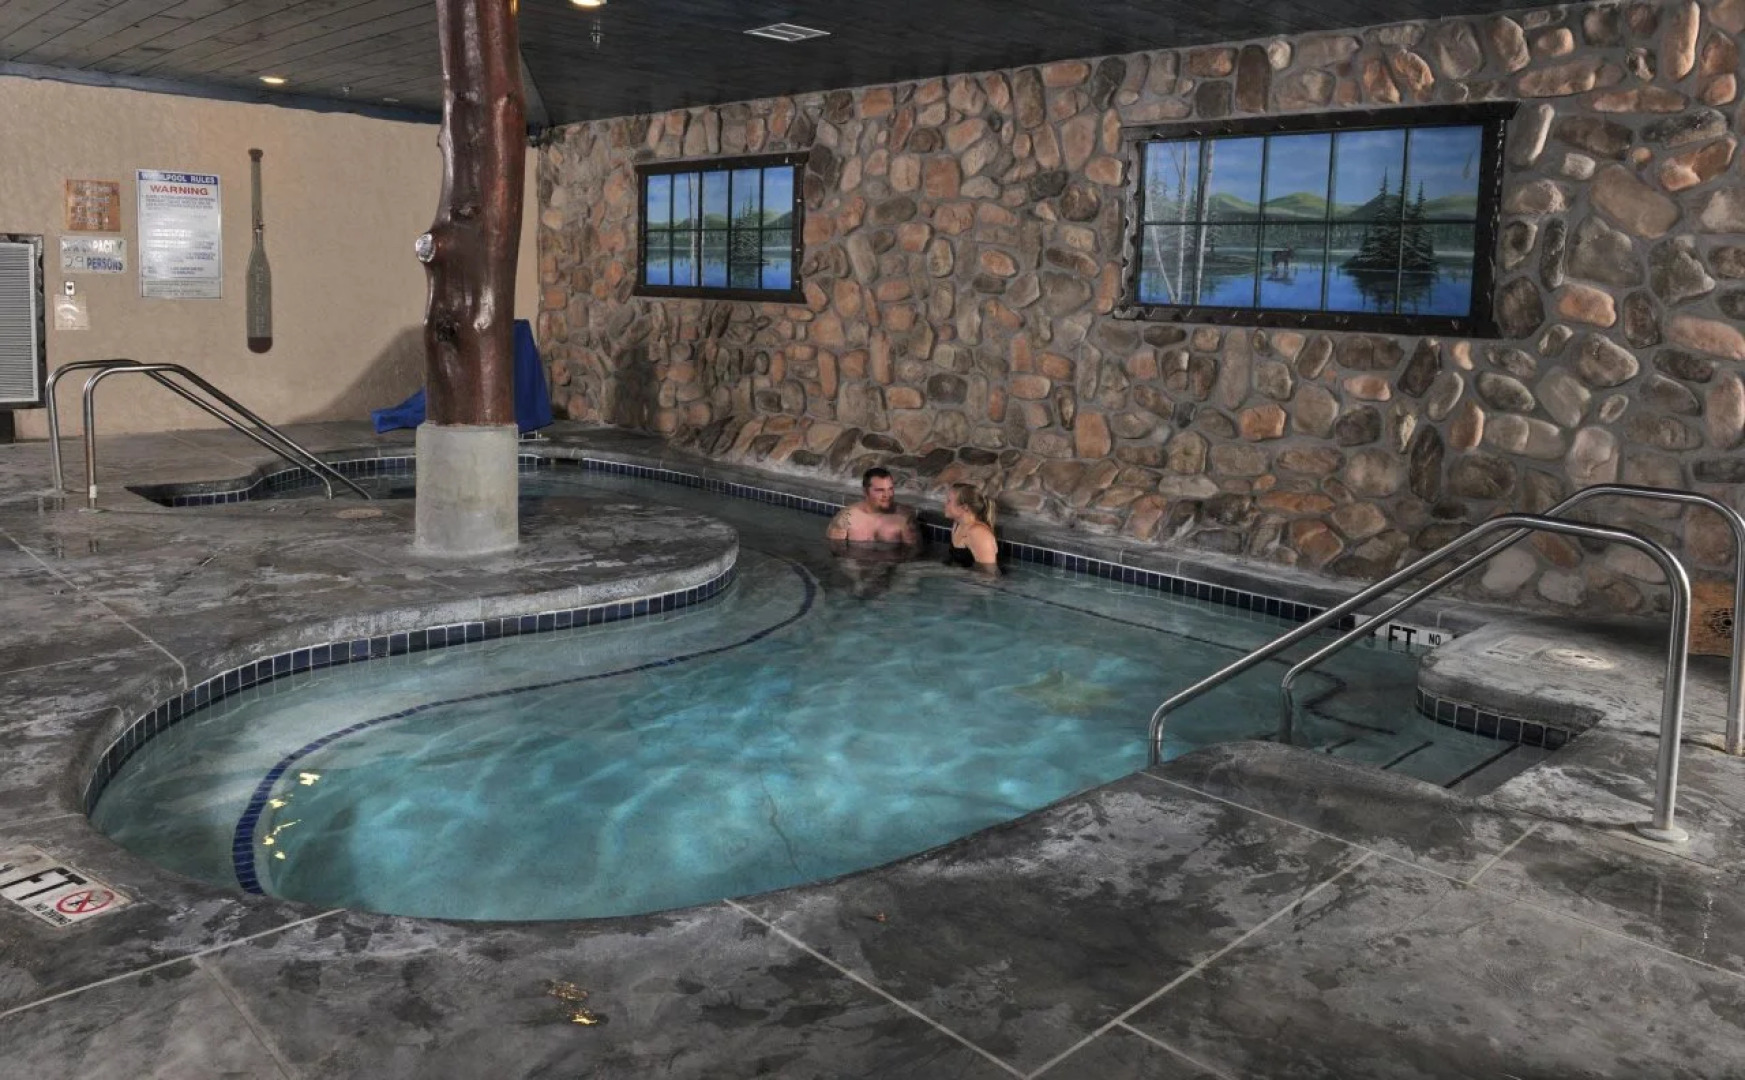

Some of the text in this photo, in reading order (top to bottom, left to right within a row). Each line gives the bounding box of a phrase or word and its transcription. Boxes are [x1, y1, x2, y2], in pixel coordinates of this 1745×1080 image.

[190, 175, 216, 184] RULES
[150, 185, 208, 196] WARNING
[1388, 624, 1417, 649] FT
[1428, 633, 1442, 646] NO
